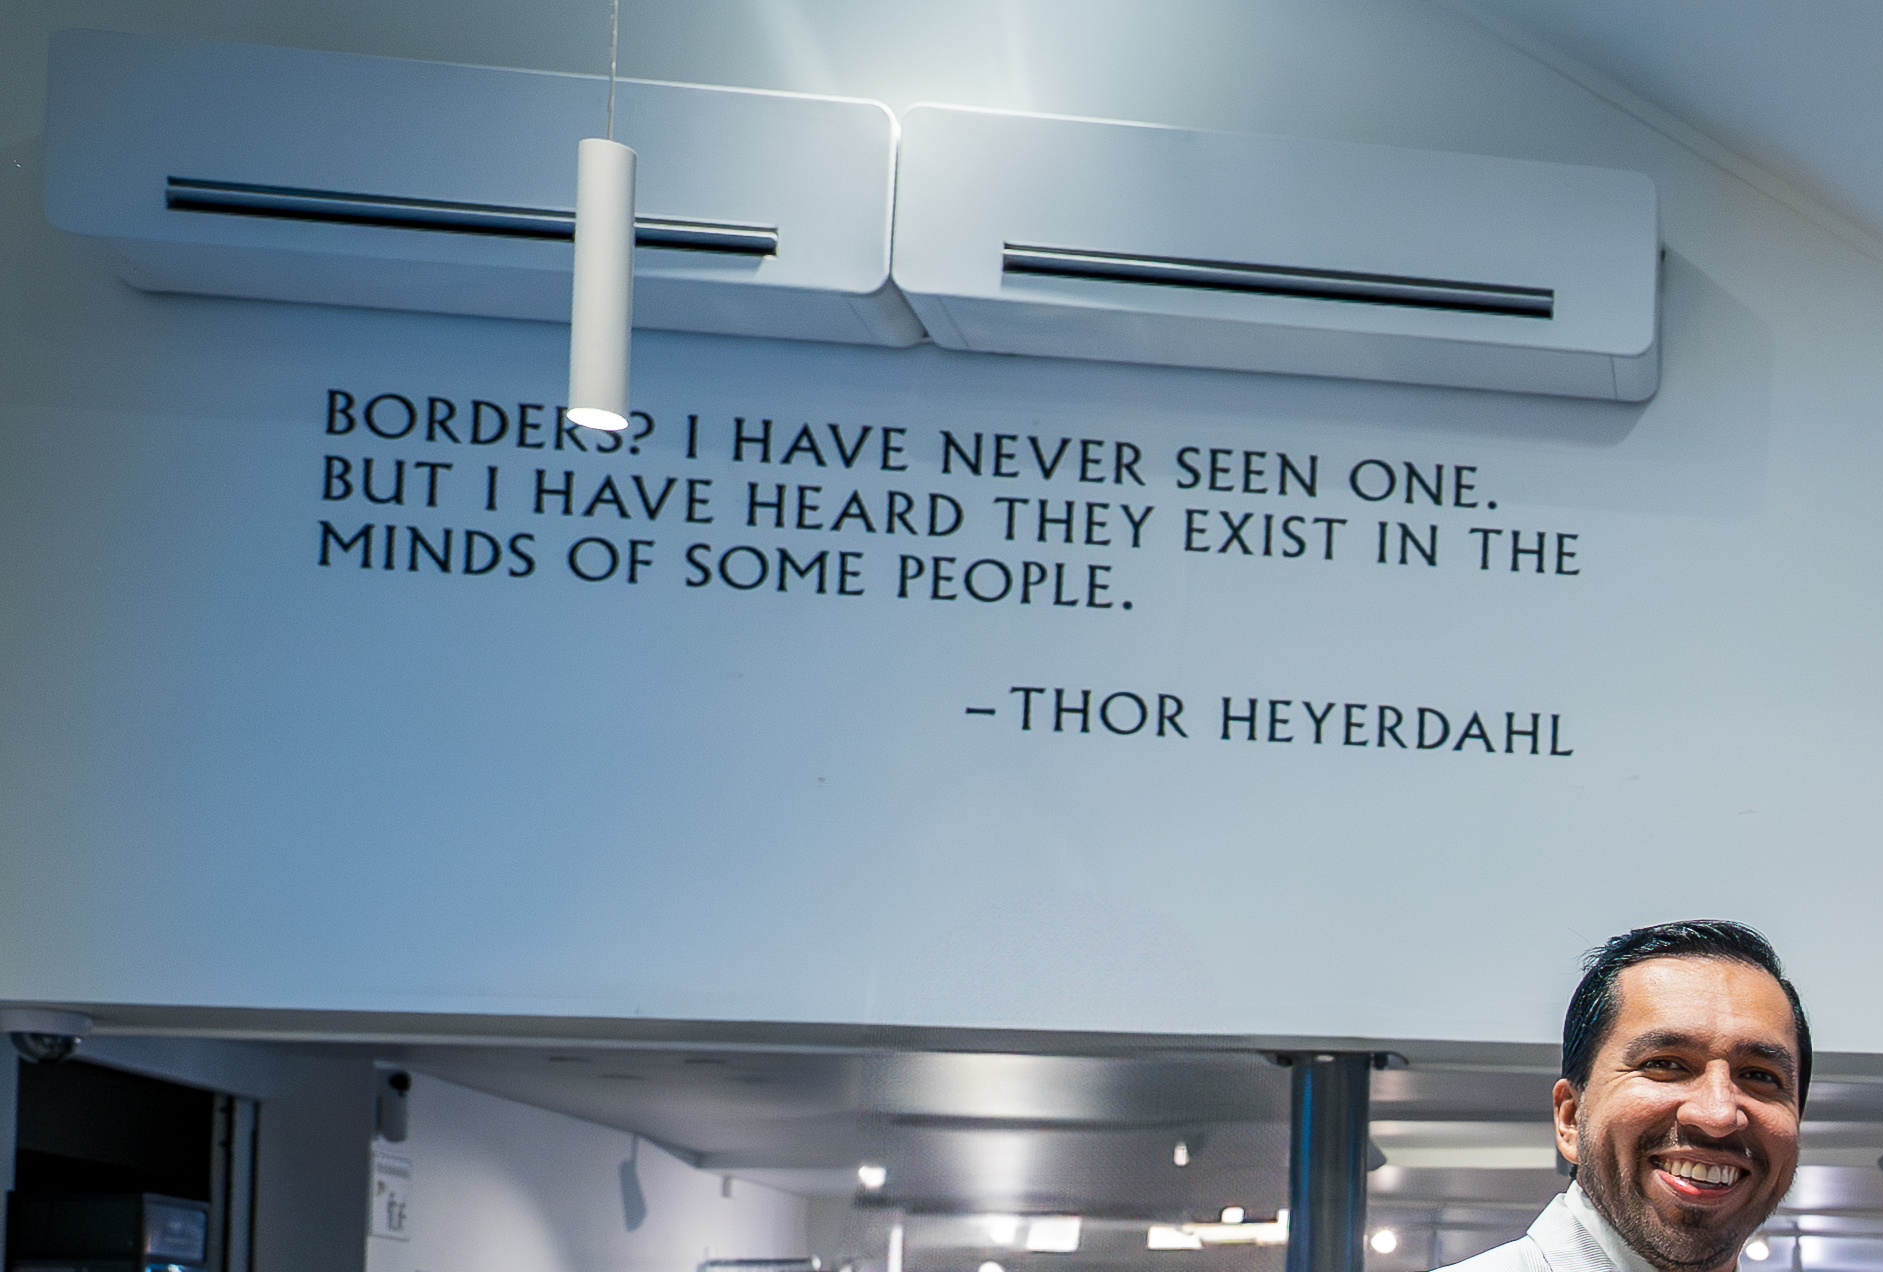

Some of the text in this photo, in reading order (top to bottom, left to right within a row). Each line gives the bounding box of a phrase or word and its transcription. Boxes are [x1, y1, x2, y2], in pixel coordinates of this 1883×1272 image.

[685, 414, 699, 459] I
[732, 416, 908, 472] HAVE
[939, 430, 1146, 487] NEVER
[1176, 446, 1319, 498] SEEN
[1348, 458, 1498, 510] ONE.
[322, 454, 1581, 576] BUT I HAVE HEARD THEY EXIST IN THE
[317, 520, 1133, 611] MINDS OF SOME PEOPLE.
[1220, 696, 1574, 757] HEYERDAHL
